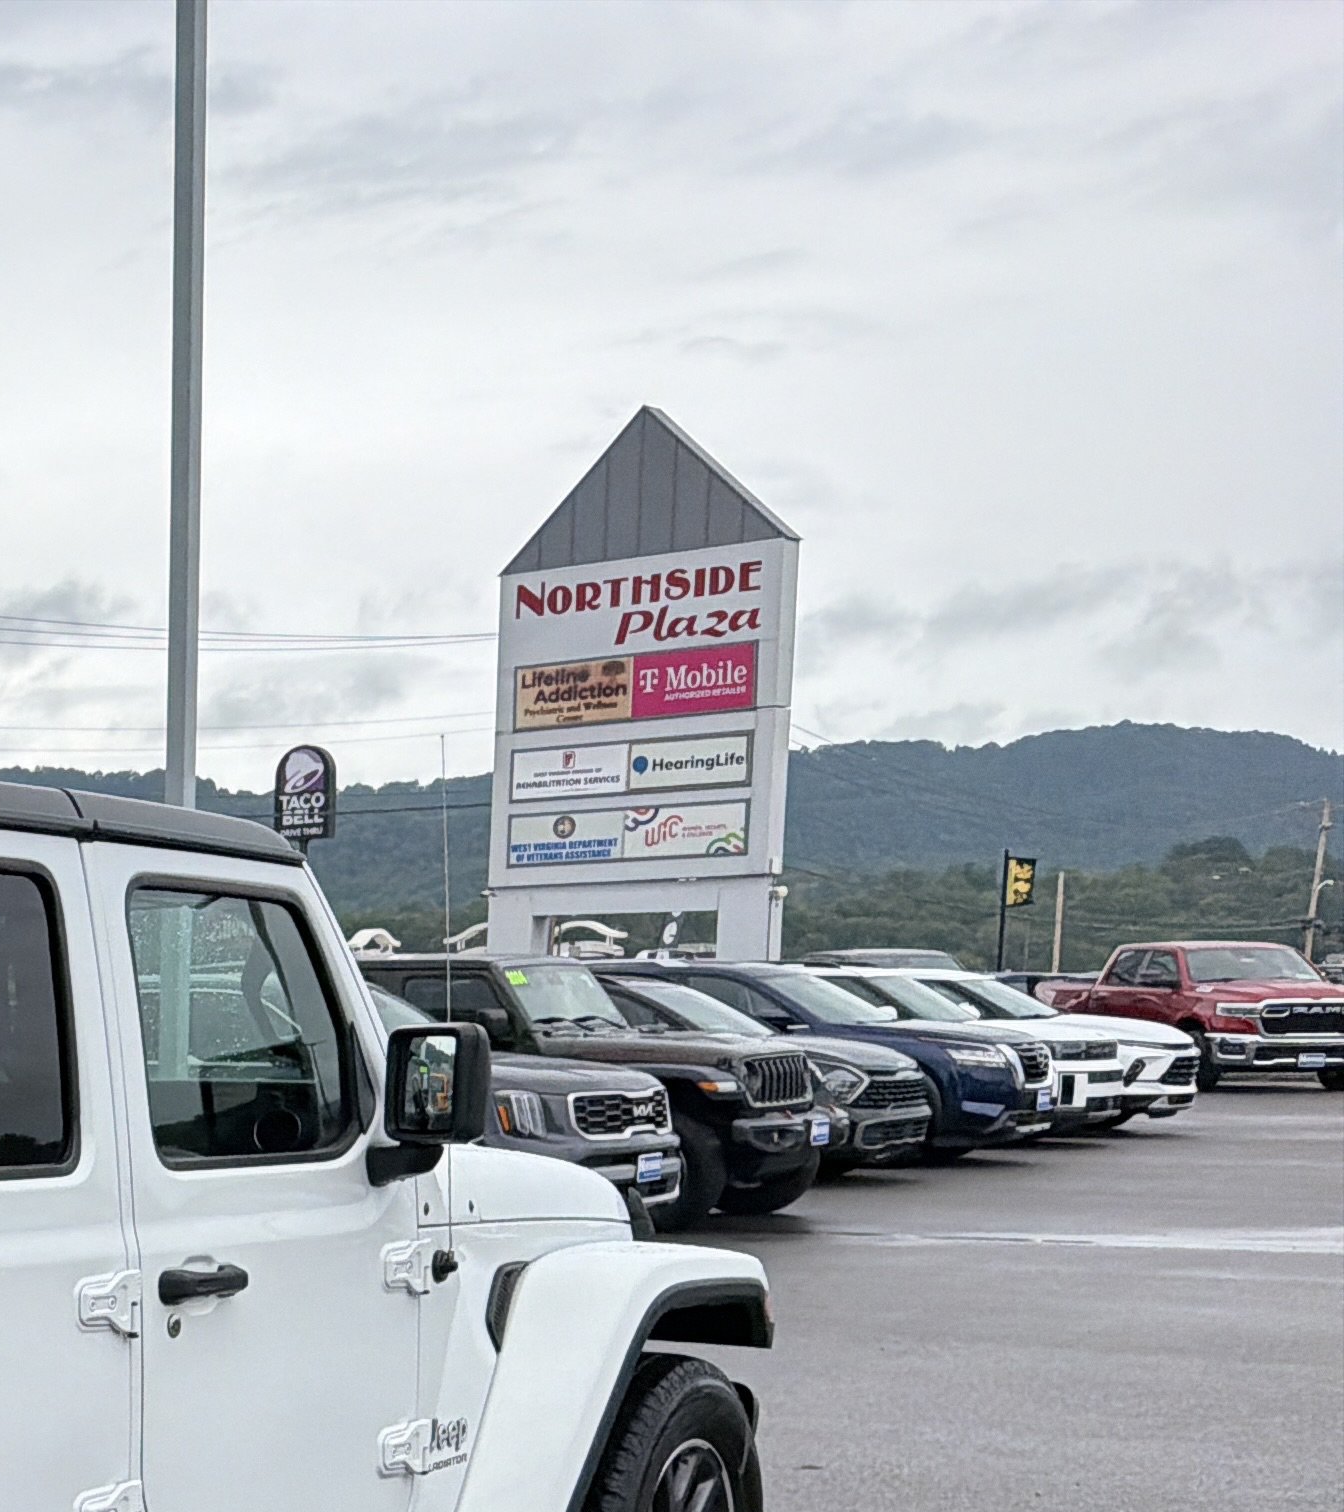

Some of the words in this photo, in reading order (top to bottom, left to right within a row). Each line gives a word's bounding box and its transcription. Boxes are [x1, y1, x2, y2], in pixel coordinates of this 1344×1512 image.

[516, 560, 763, 619] NORTHSIDE
[614, 606, 761, 645] Plaza
[521, 668, 591, 689] Lifeline
[664, 660, 748, 692] Mobile
[534, 682, 627, 705] Addiction
[652, 752, 745, 772] HearingLife
[516, 777, 581, 790] REHABILITATION
[583, 775, 621, 786] SERVICES
[279, 791, 325, 811] TACO
[282, 808, 324, 826] BELL
[429, 1417, 468, 1453] Jeep
